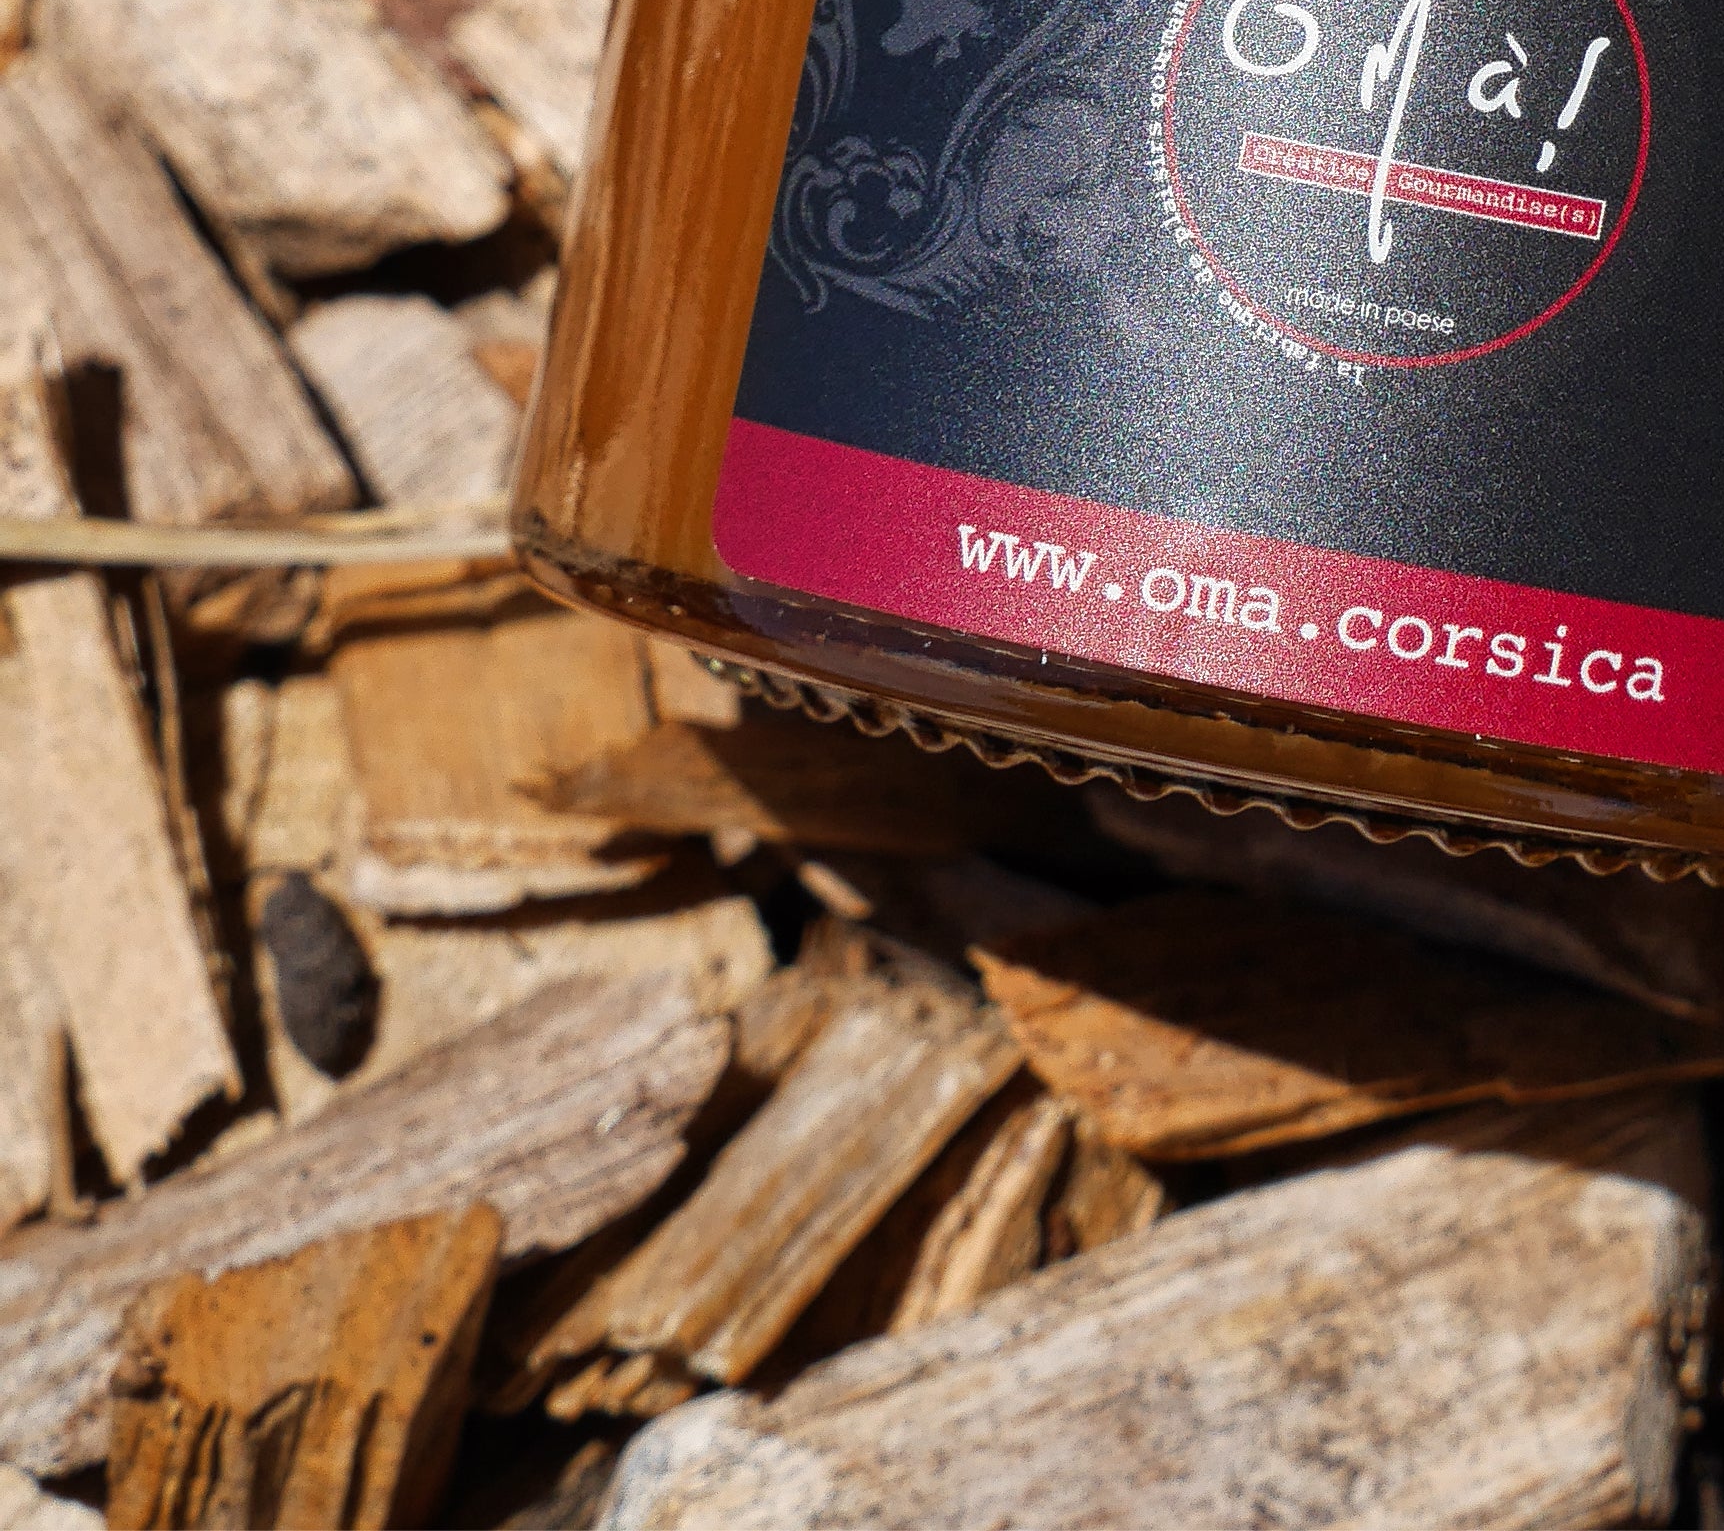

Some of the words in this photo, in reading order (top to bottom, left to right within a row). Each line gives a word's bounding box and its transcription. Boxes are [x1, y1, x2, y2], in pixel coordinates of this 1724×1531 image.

[1397, 171, 1597, 229] Gourmandise(s)
[1285, 288, 1354, 315] made
[1384, 305, 1455, 335] paese
[956, 523, 1667, 706] www.oma.corsica
